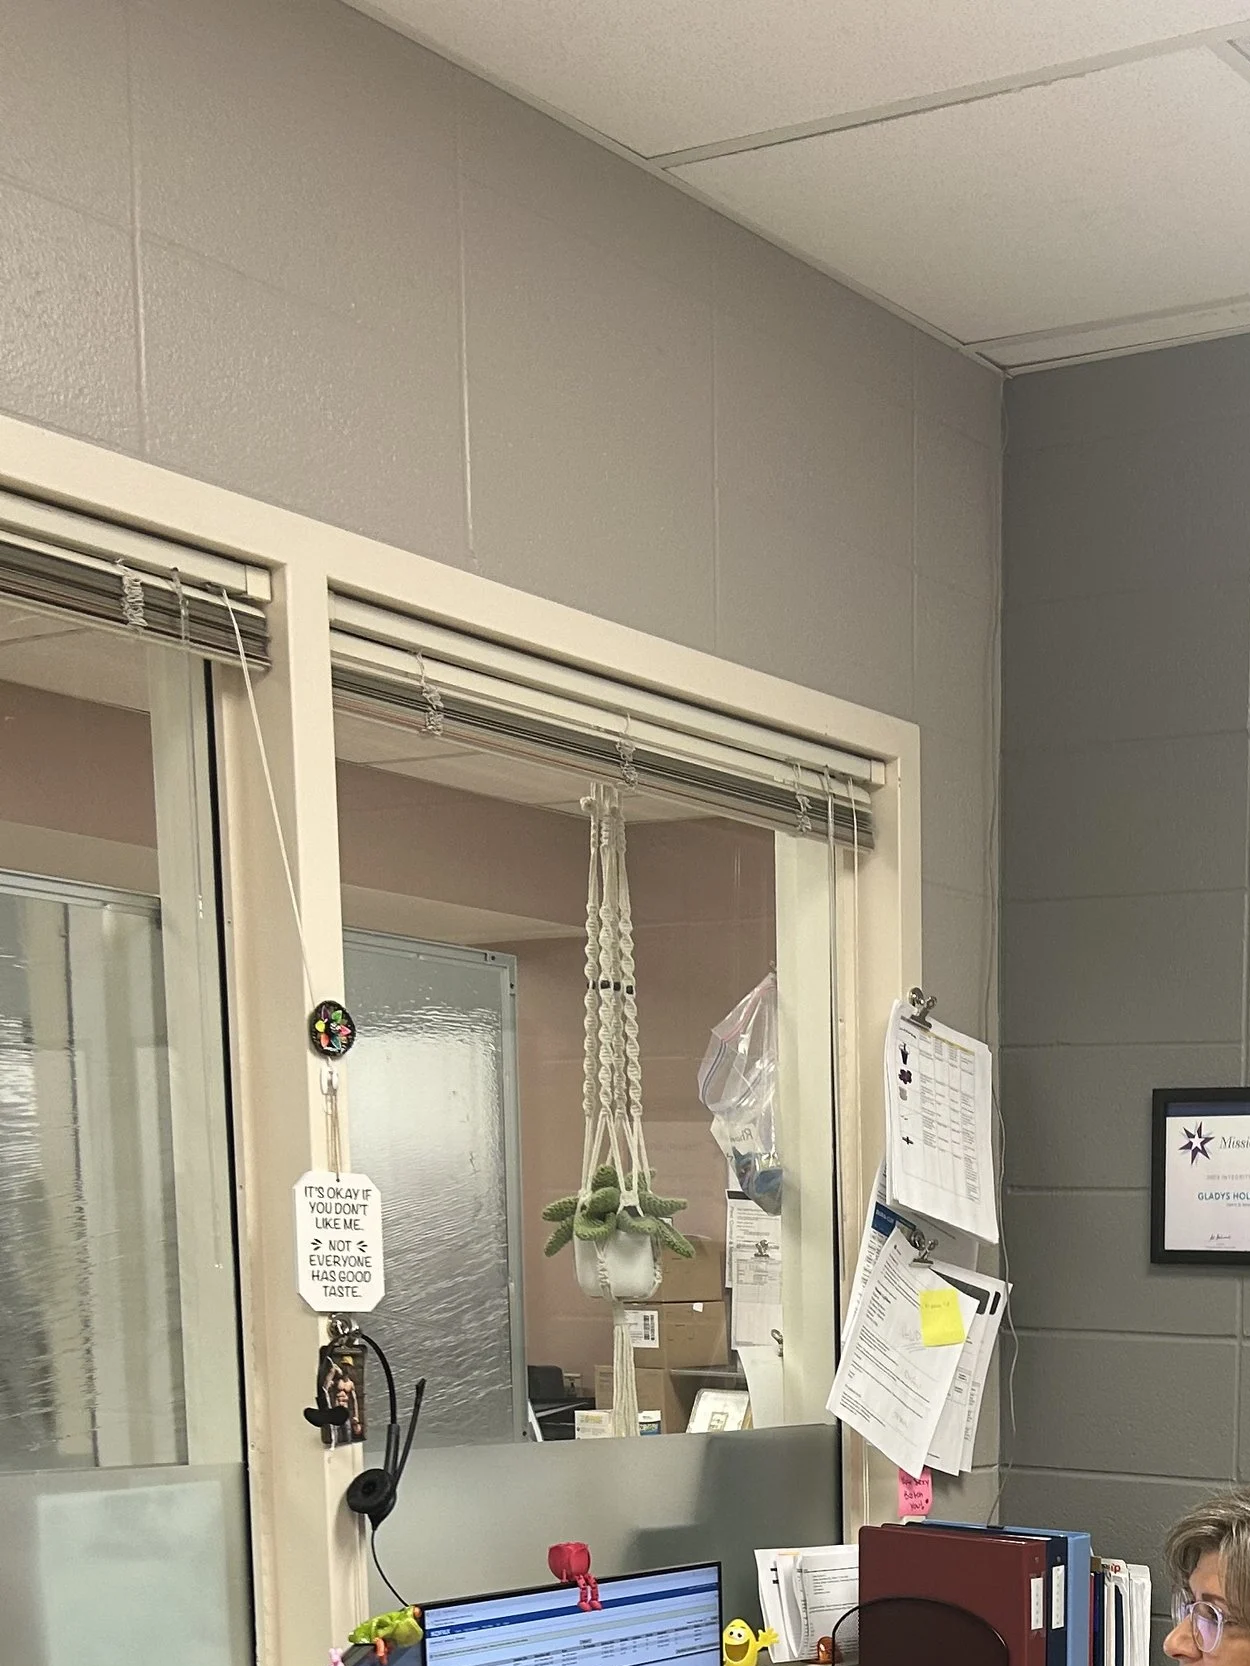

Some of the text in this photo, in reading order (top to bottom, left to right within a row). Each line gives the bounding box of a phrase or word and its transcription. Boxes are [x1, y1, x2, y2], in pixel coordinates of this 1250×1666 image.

[305, 1186, 372, 1201] IT'S OKAY IF
[1198, 1192, 1231, 1201] GLADYS
[309, 1202, 368, 1216] YOU DON'T
[315, 1218, 364, 1231] LIKE ME.
[329, 1240, 352, 1252] NOT
[309, 1254, 372, 1268] EVERYONE
[311, 1270, 372, 1283] HAS GOOD
[323, 1285, 363, 1298] TASTE.
